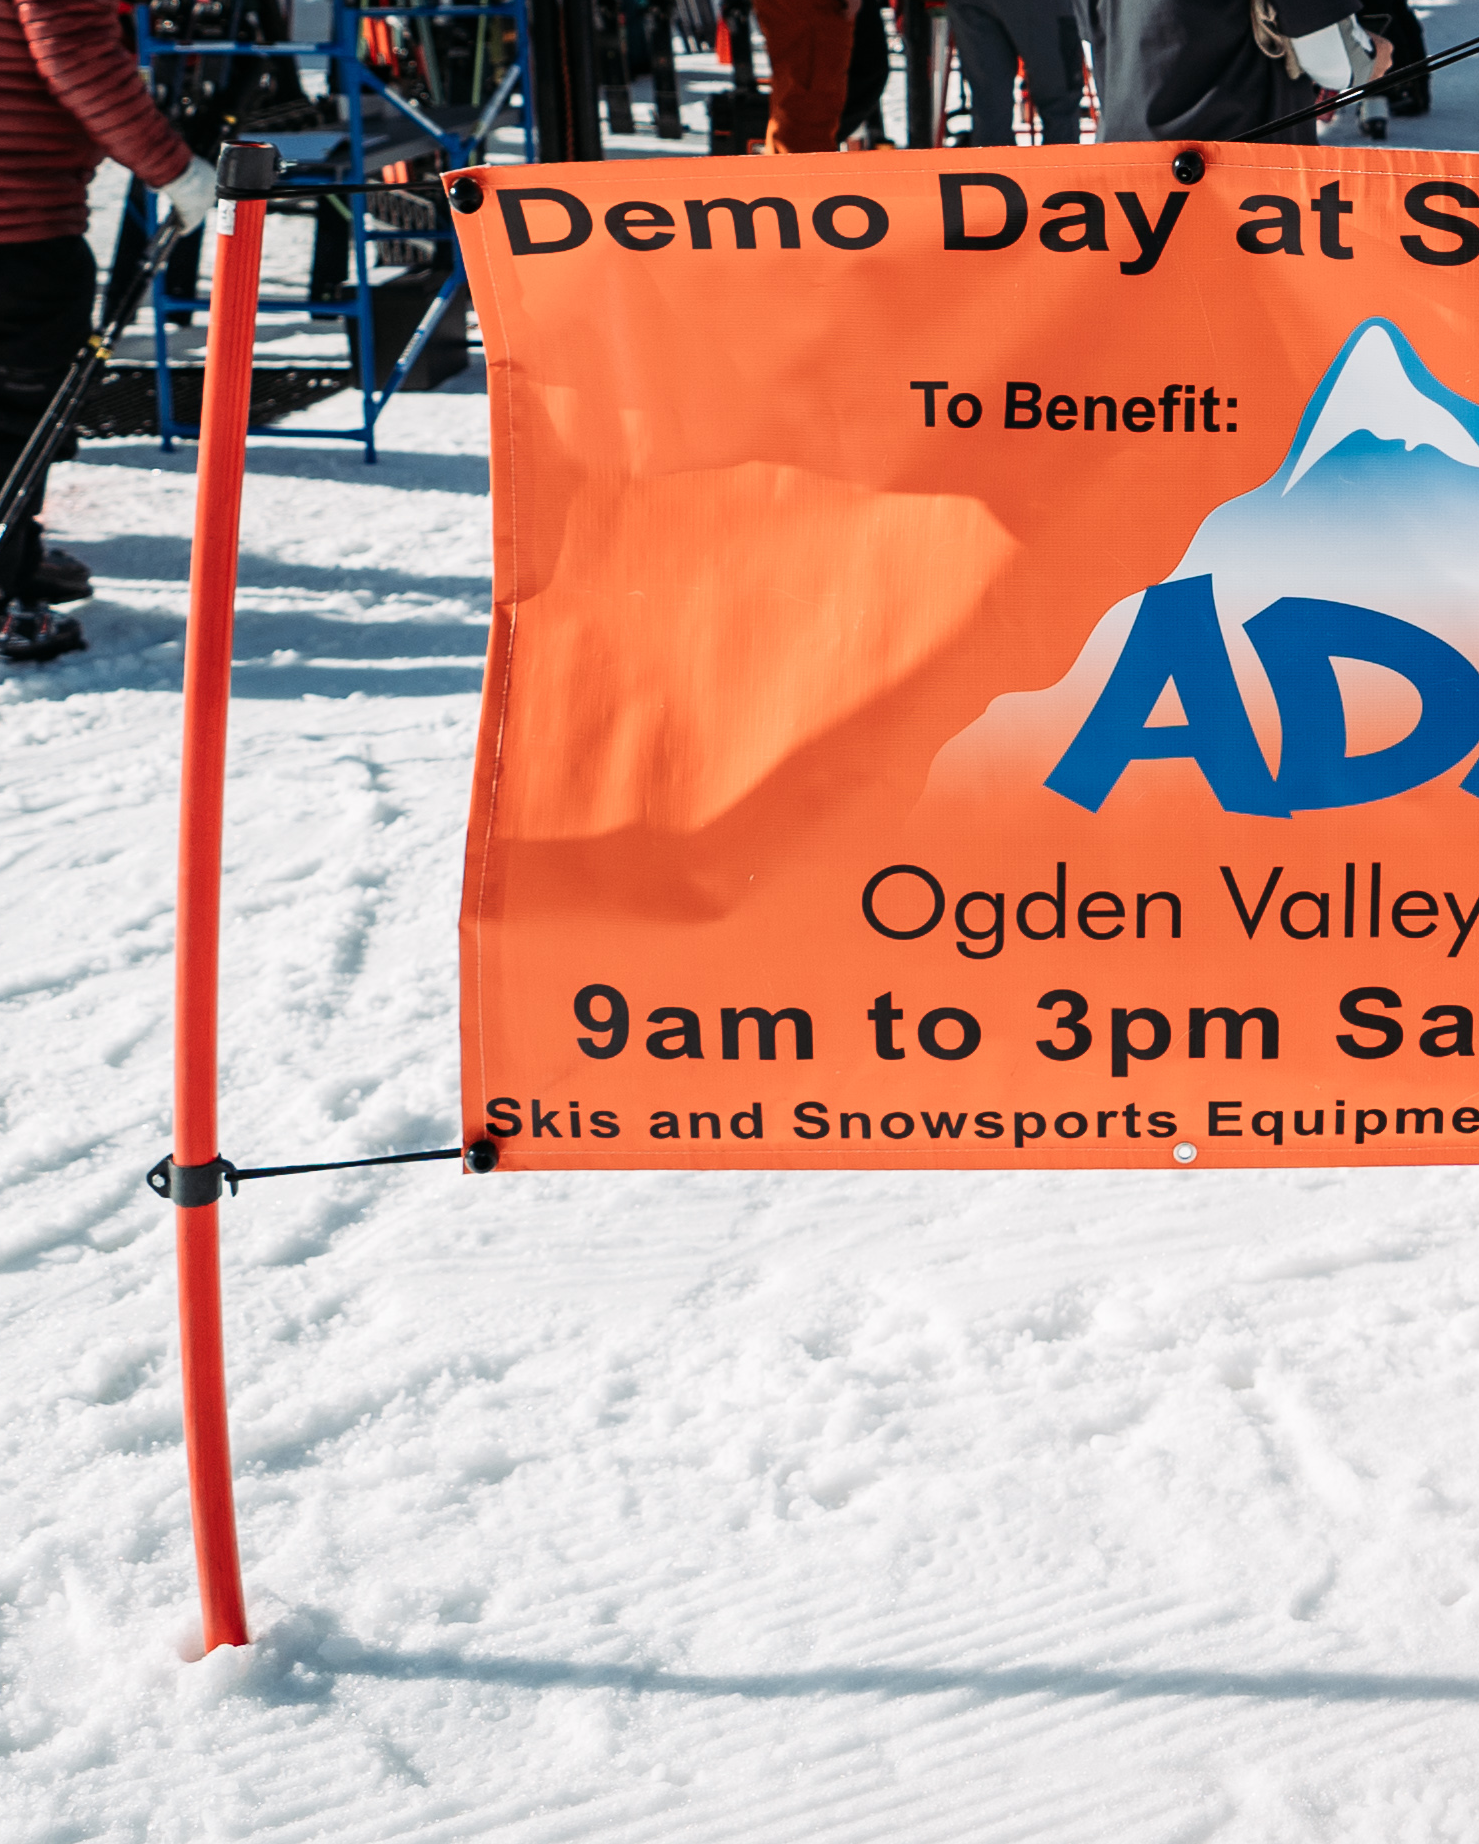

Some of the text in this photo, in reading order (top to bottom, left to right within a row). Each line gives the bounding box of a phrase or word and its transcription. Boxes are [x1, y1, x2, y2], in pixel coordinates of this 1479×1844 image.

[496, 188, 888, 255] Demo
[939, 173, 1189, 275] Day
[1236, 181, 1353, 259] at
[910, 382, 1237, 432] To Benefit:
[862, 862, 1181, 959] Ogden
[574, 984, 813, 1060] 9am
[868, 992, 981, 1060] to
[1036, 990, 1278, 1077] 3pm
[486, 1098, 619, 1138] Skis
[650, 1103, 762, 1139] and
[794, 1102, 1176, 1148] Snowsports
